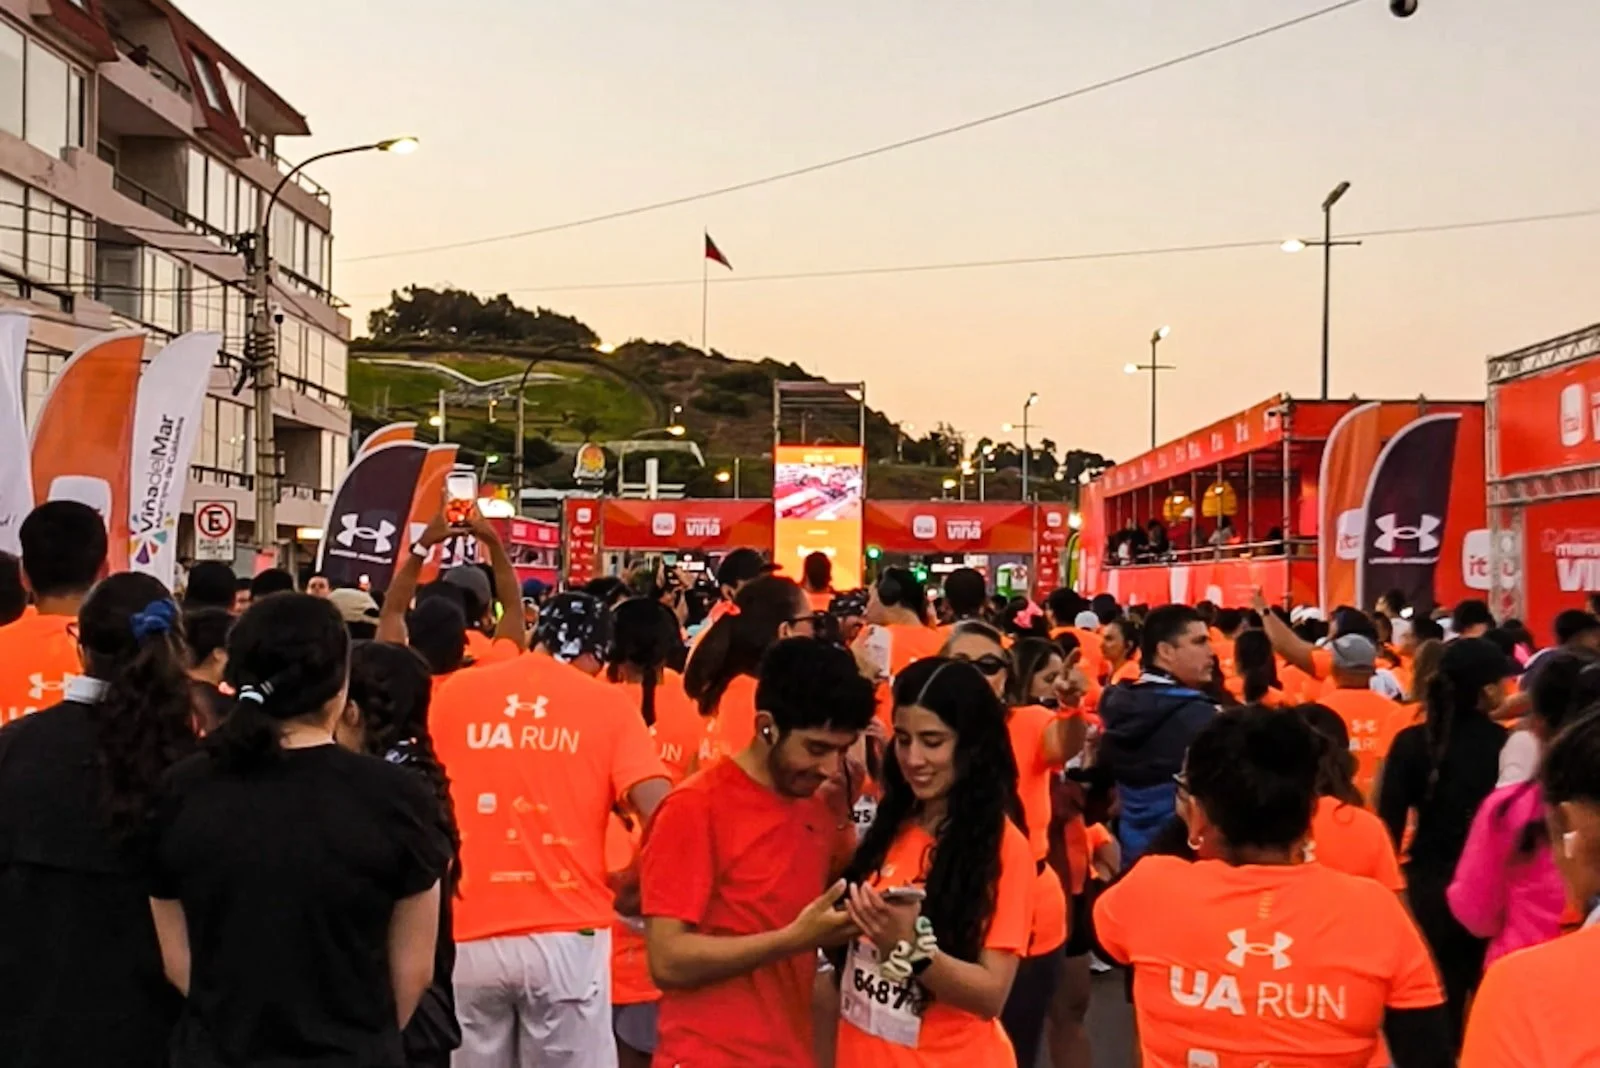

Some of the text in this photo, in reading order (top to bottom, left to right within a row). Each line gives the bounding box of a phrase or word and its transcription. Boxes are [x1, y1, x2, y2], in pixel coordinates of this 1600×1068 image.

[208, 510, 223, 531] E
[467, 723, 580, 754] UA RUN
[1170, 964, 1346, 1020] UA RUN
